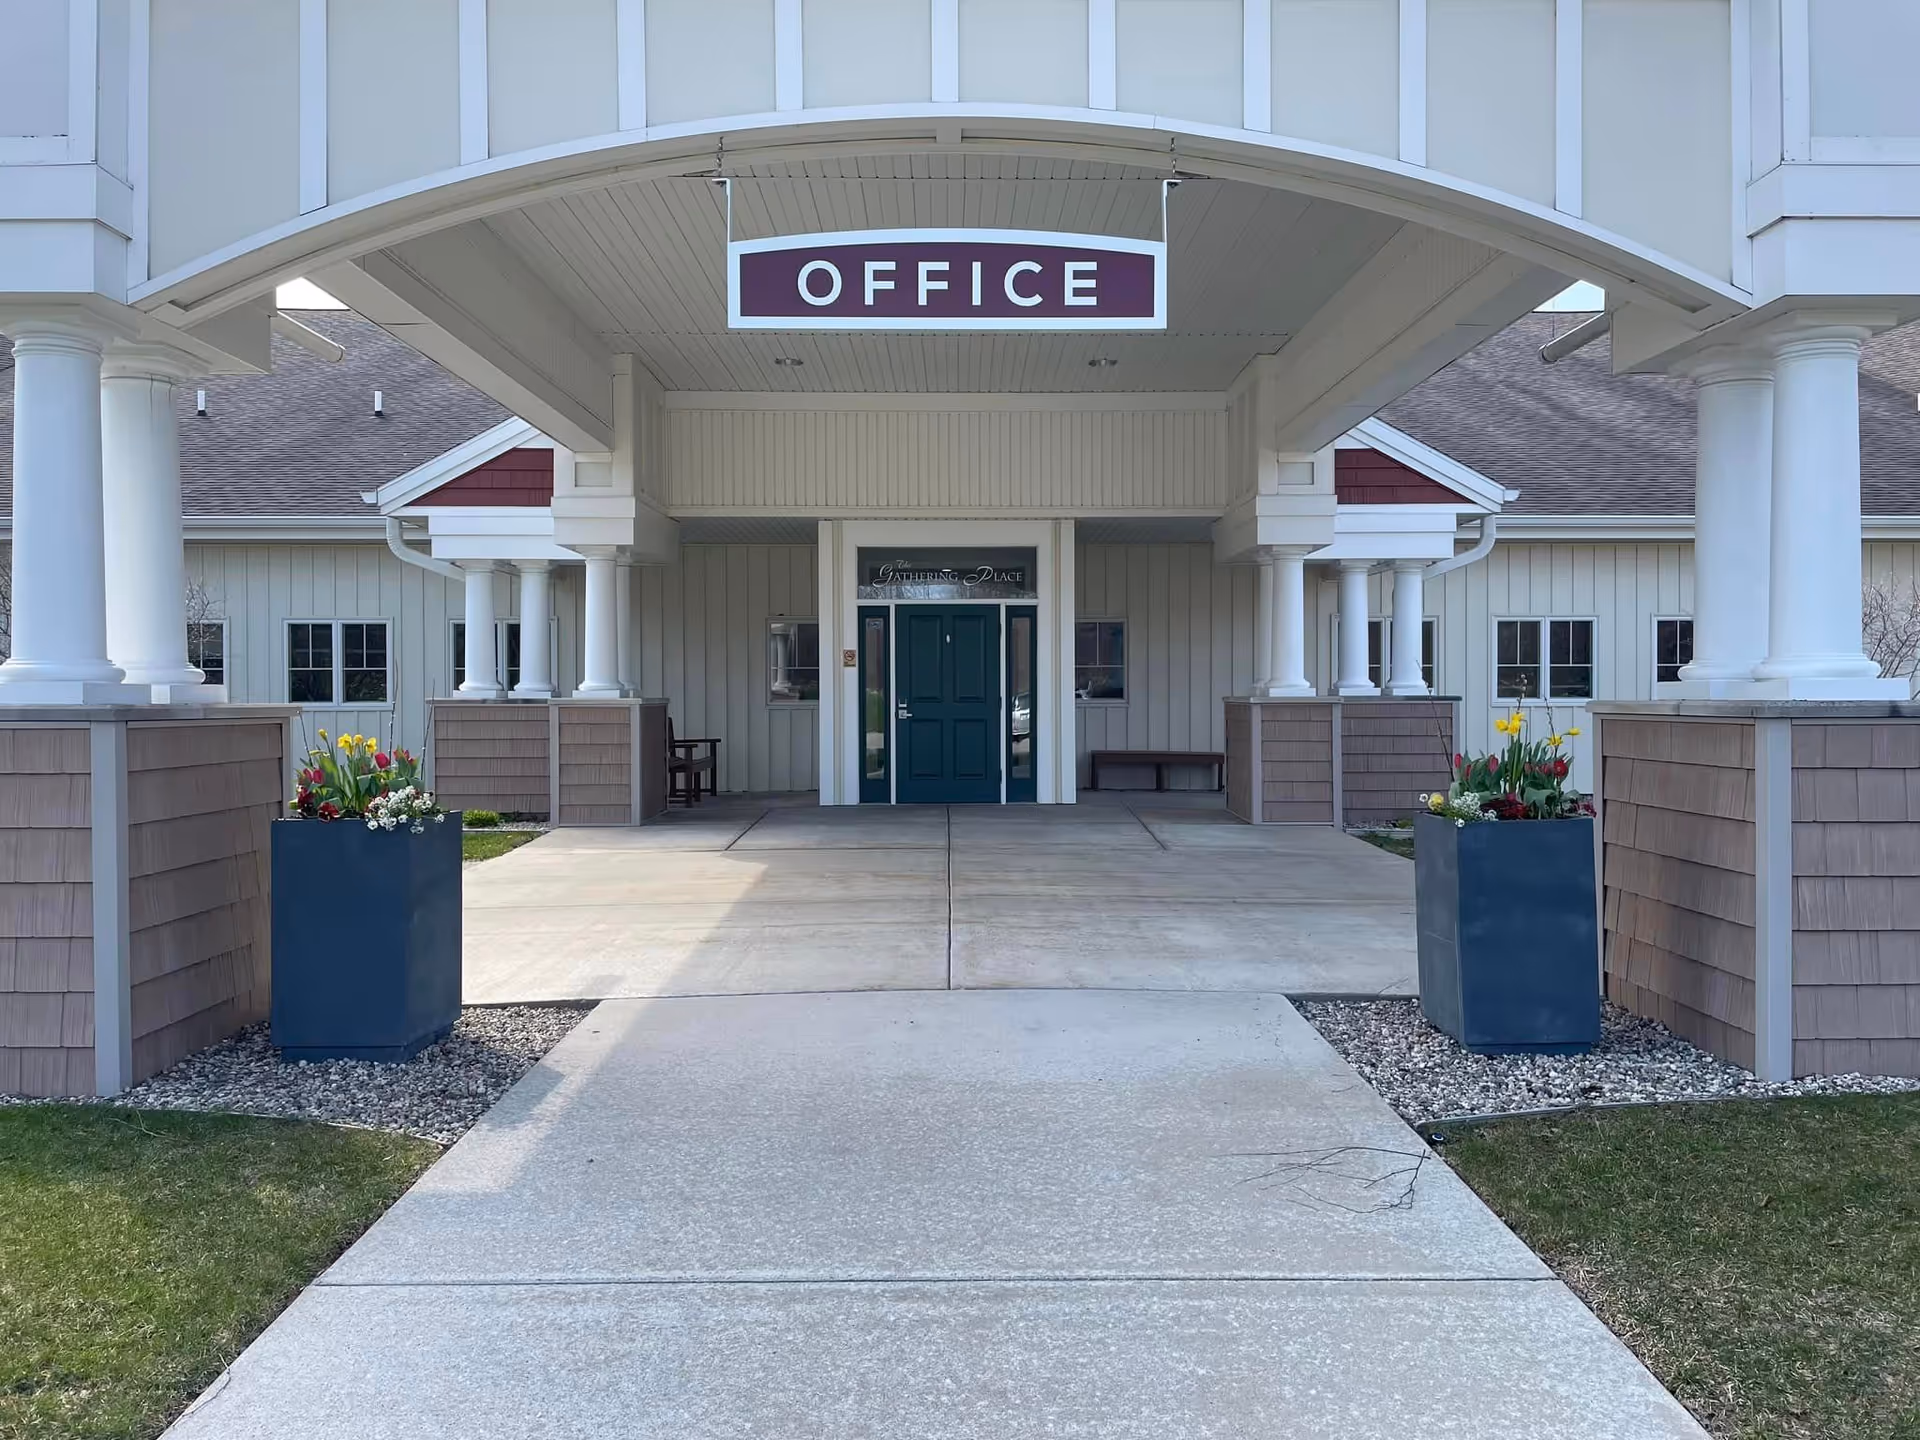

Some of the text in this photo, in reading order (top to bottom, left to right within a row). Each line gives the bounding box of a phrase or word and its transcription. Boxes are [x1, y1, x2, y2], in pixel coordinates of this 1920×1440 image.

[797, 260, 1099, 307] OFFICE
[872, 563, 1023, 588] GATHERING PLACE
